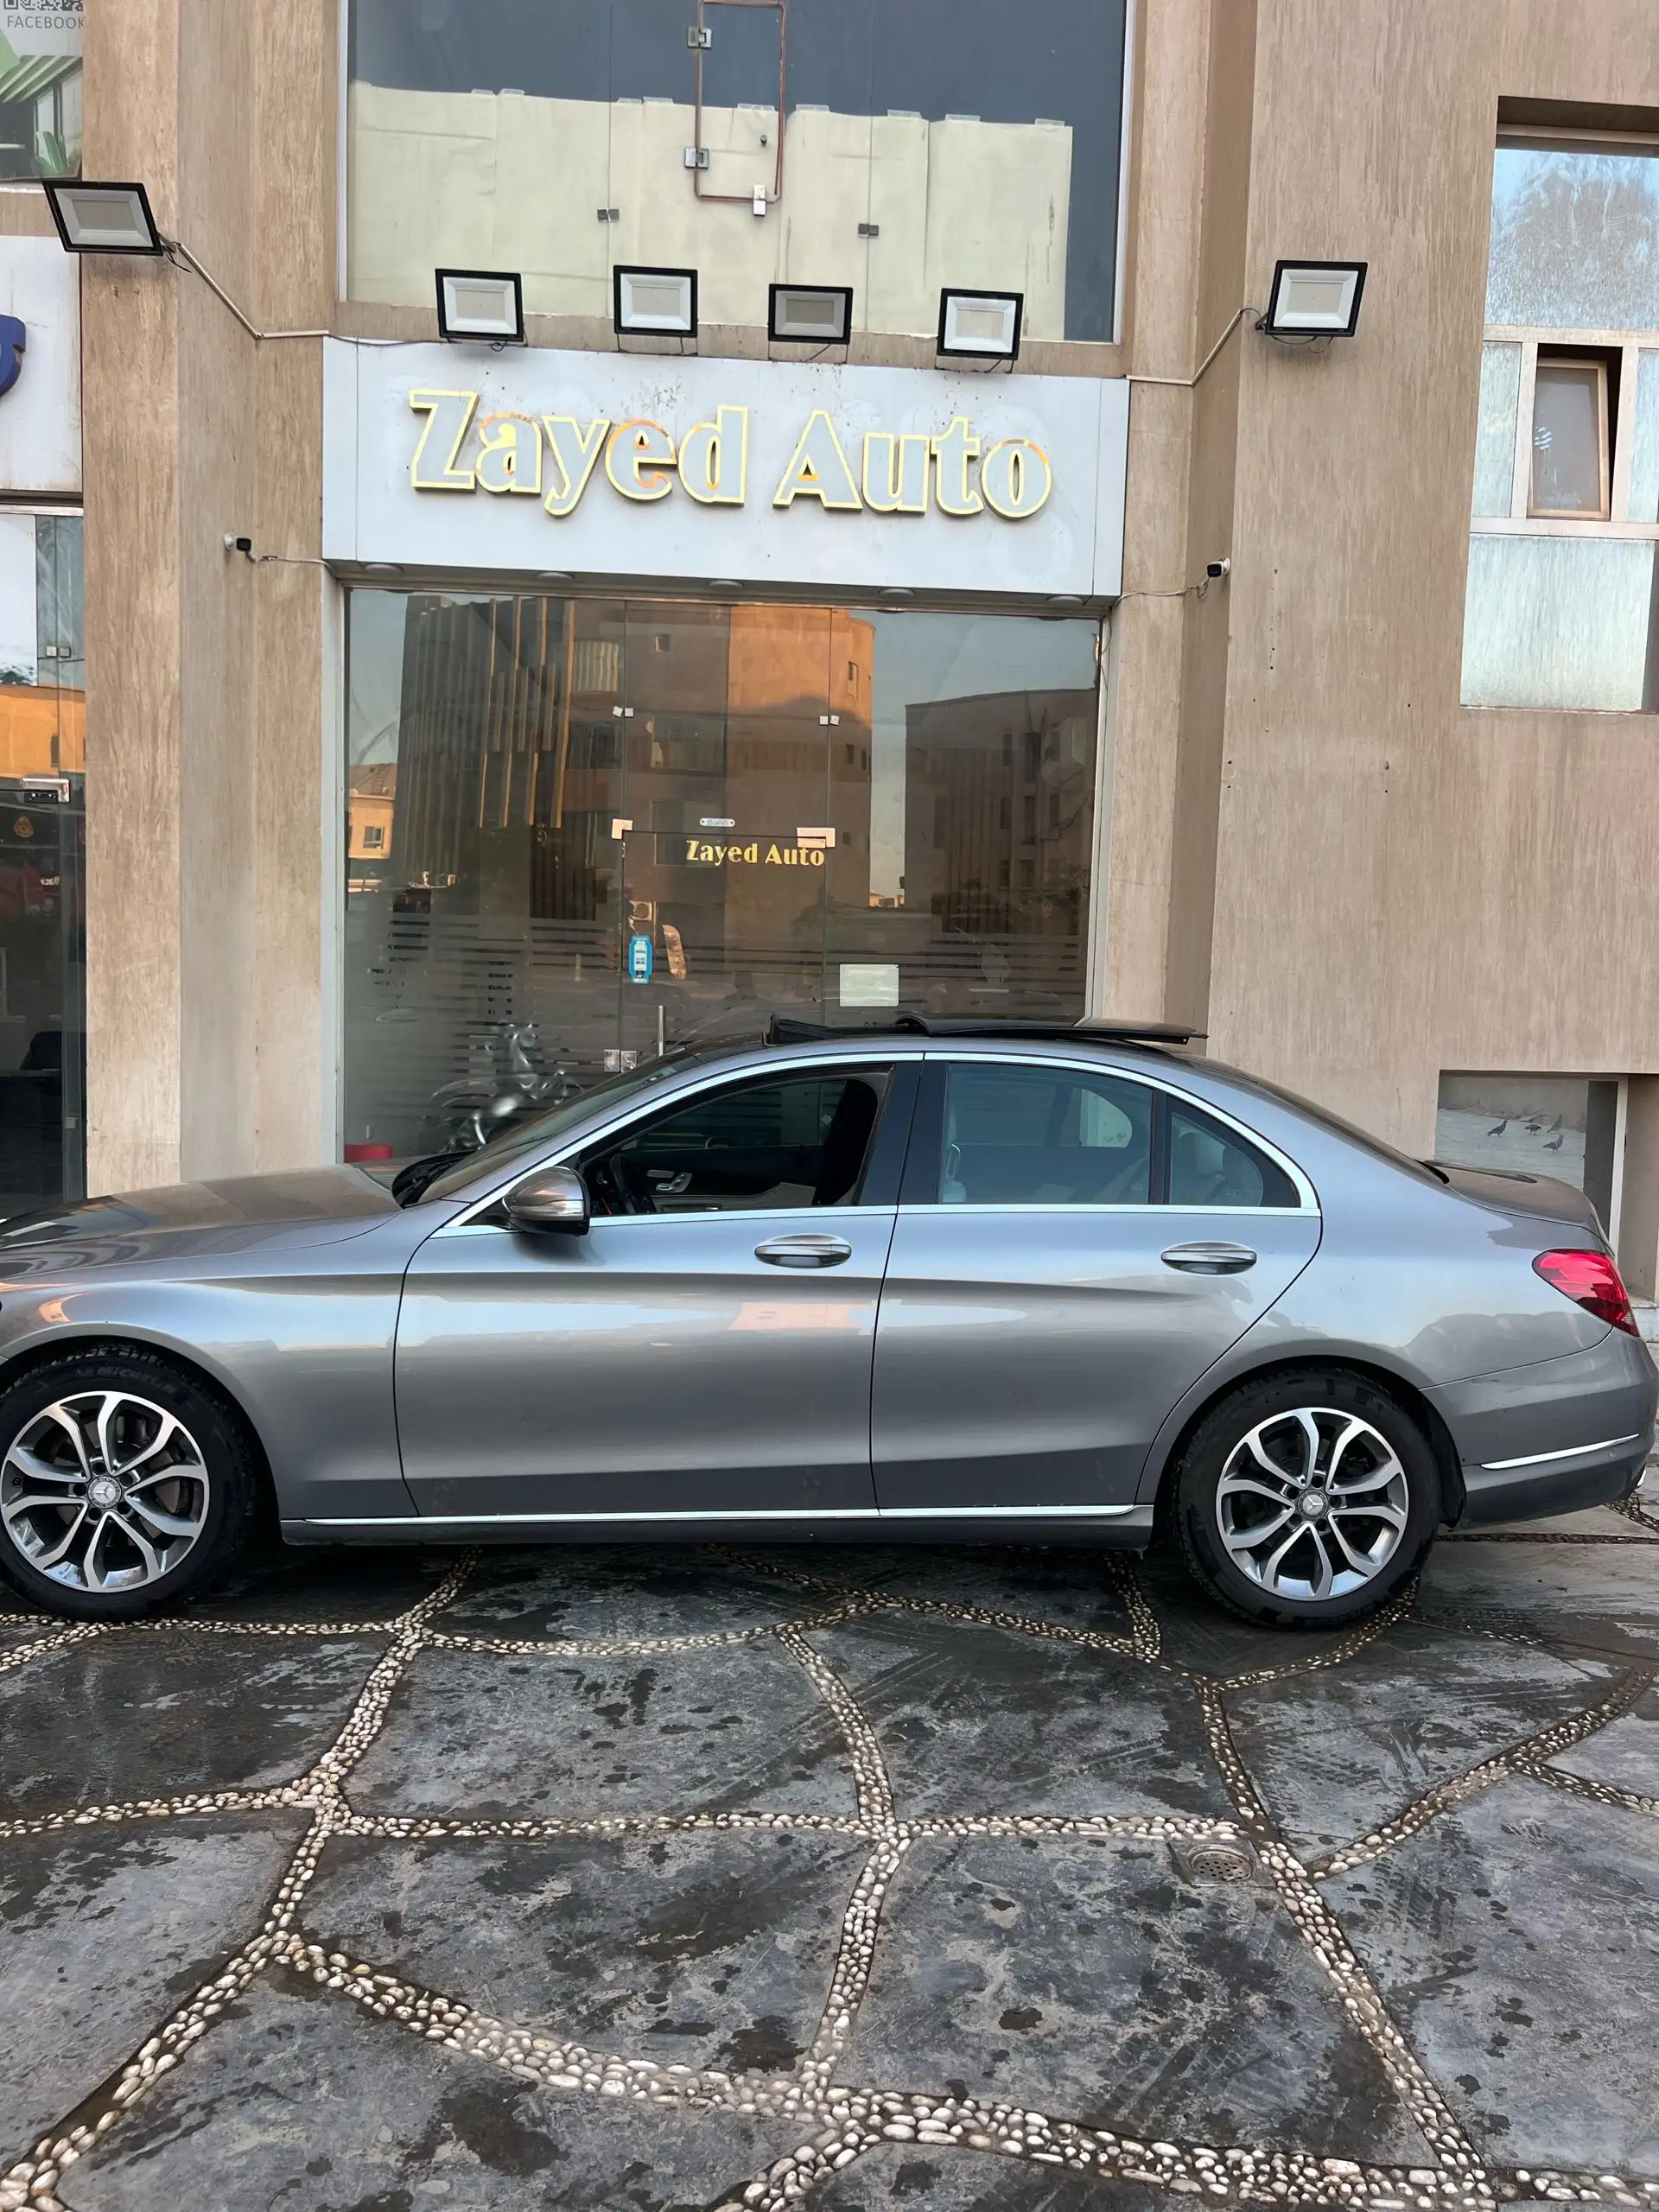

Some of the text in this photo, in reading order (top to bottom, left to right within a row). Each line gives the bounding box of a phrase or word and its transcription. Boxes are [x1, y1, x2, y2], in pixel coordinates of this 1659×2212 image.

[7, 16, 84, 29] FACEBOOK
[409, 388, 1052, 520] Zayed Auto
[685, 839, 825, 867] Zayed Auto
